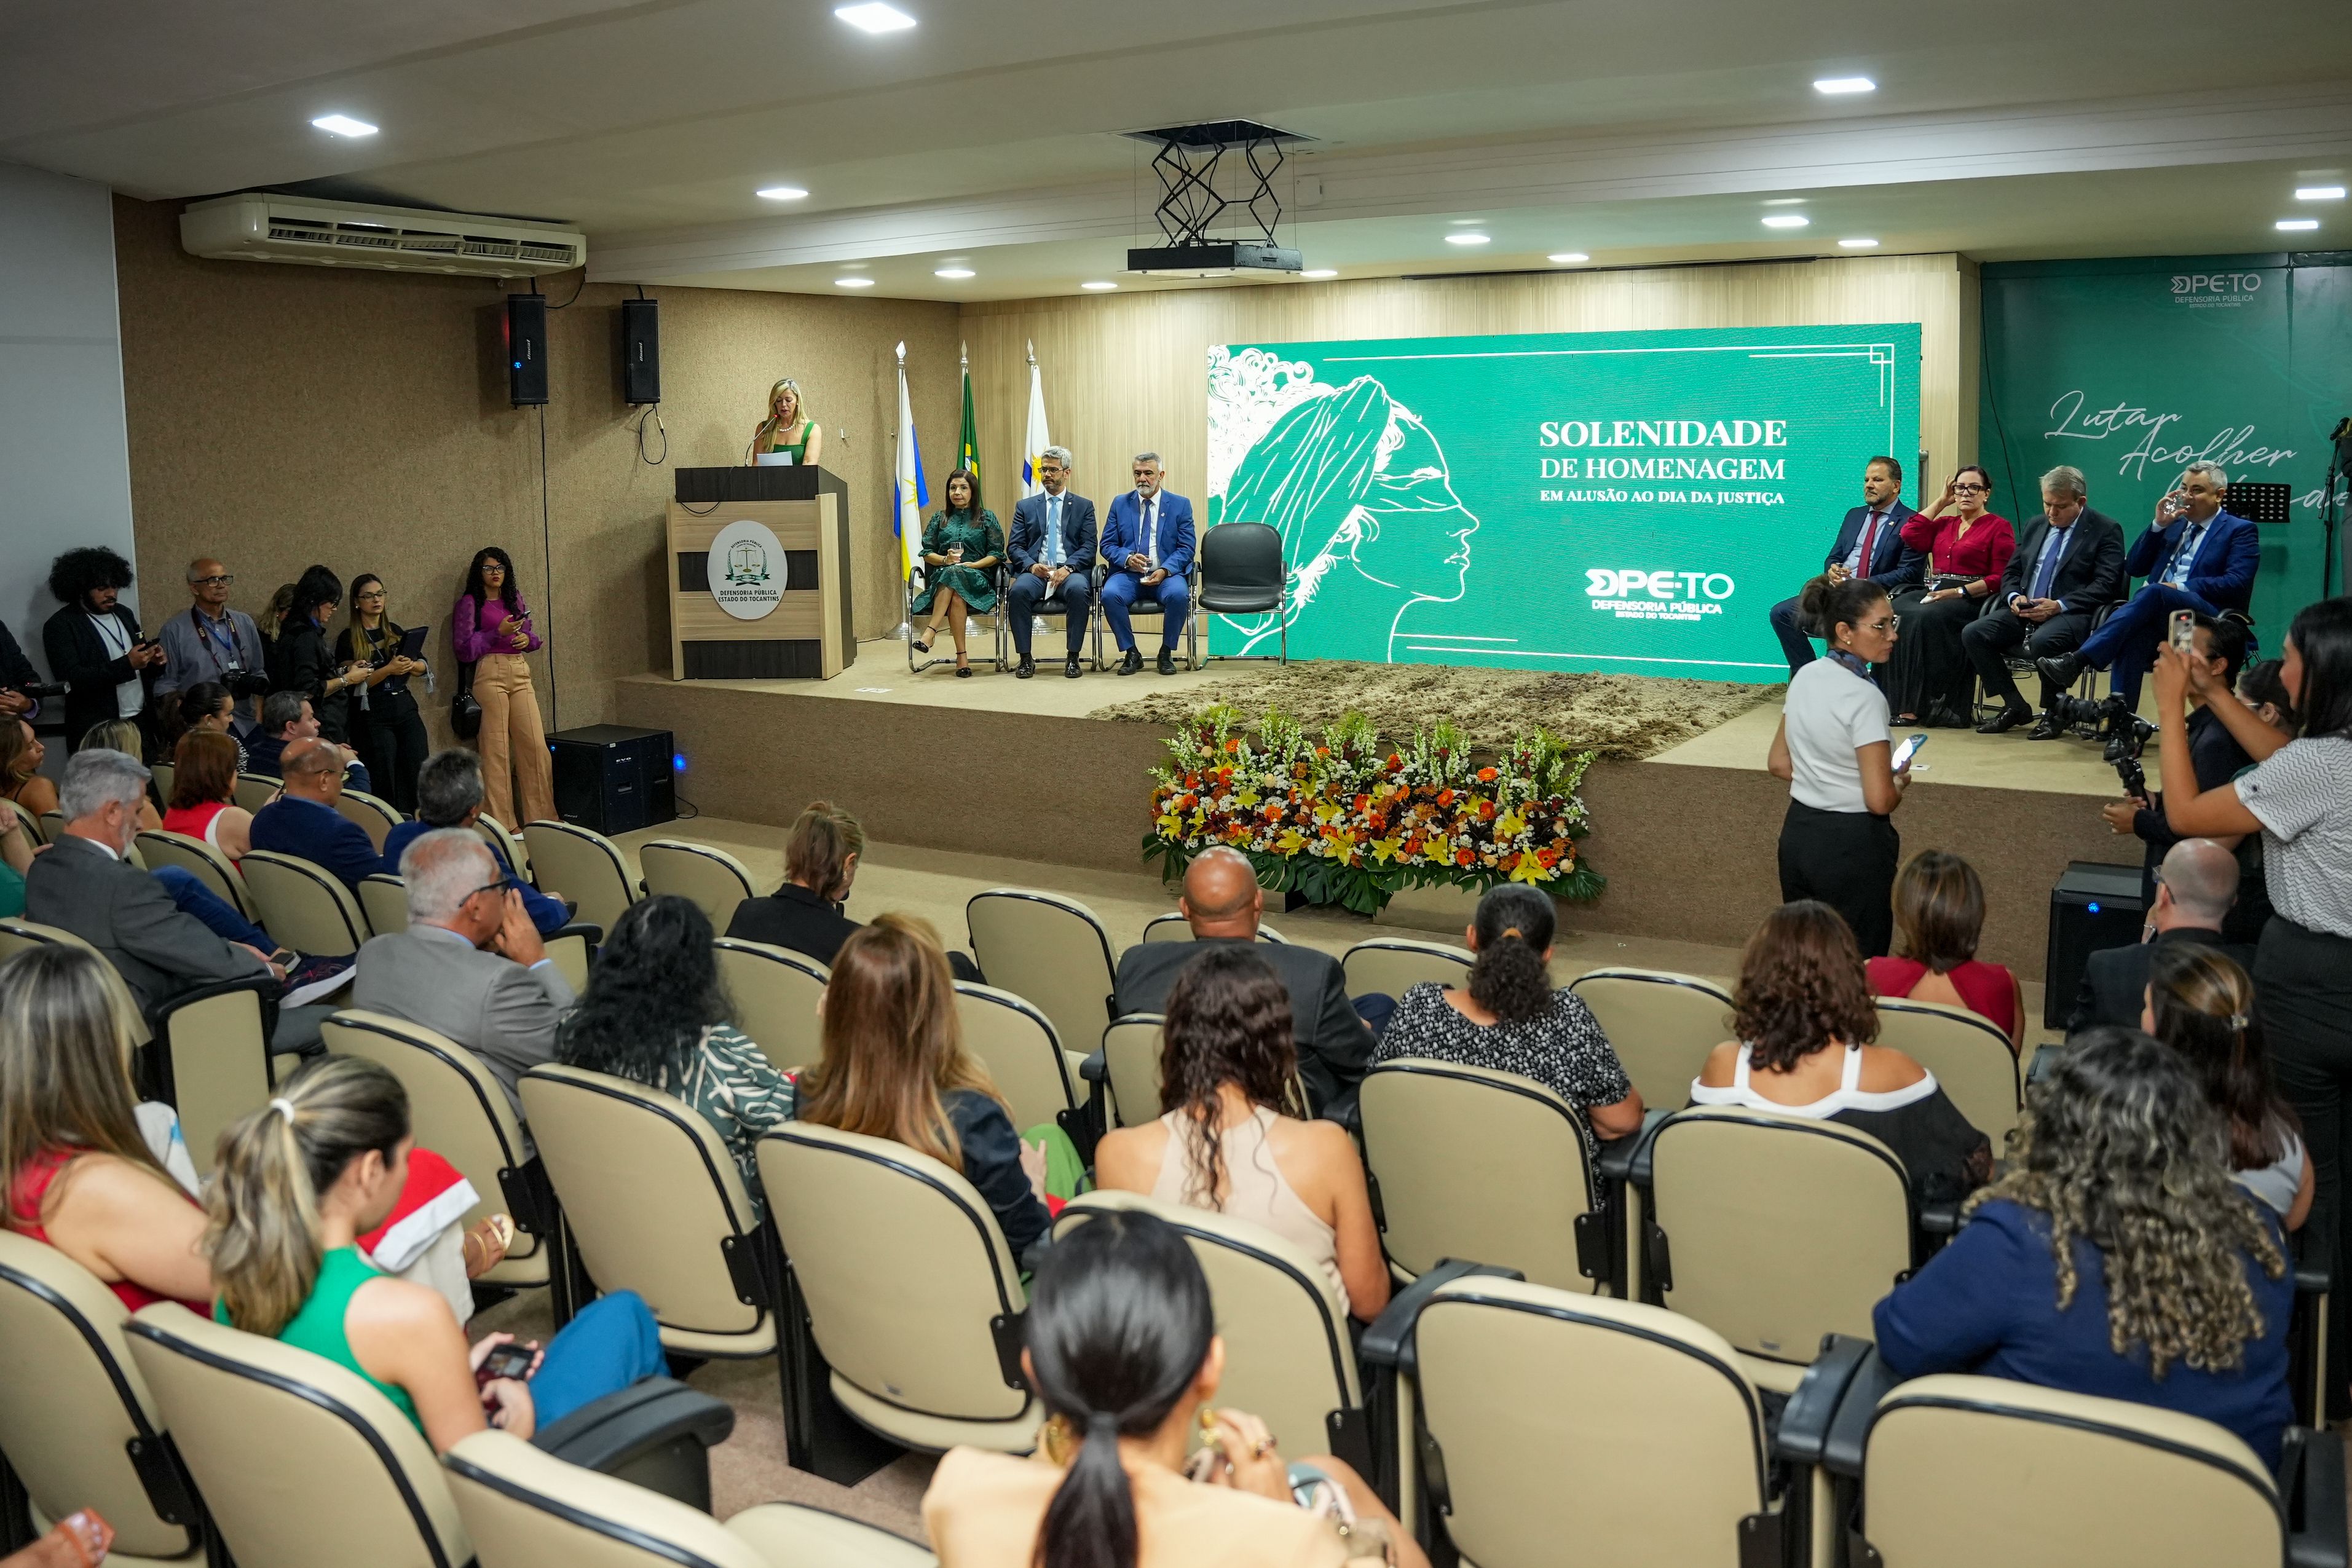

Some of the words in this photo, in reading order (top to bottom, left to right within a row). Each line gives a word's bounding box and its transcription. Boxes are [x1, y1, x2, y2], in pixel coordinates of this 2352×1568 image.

[2222, 294, 2254, 302] PÚBLICA
[2045, 390, 2182, 439] Lutar
[1539, 420, 1787, 447] SOLENIDADE
[2120, 425, 2297, 481] Acolher
[1539, 458, 1579, 479] DE
[1585, 457, 1786, 480] HOMENAGEM
[1541, 490, 1563, 502] EM
[1566, 489, 1627, 503] ALUSÃO
[1631, 490, 1654, 502] AO
[1659, 491, 1686, 503] DIA
[1691, 492, 1714, 503] DA
[1716, 492, 1785, 506] JUSTIÇA
[1592, 599, 1667, 612] DEFENSORIA
[1670, 601, 1723, 615] PÚBLICA
